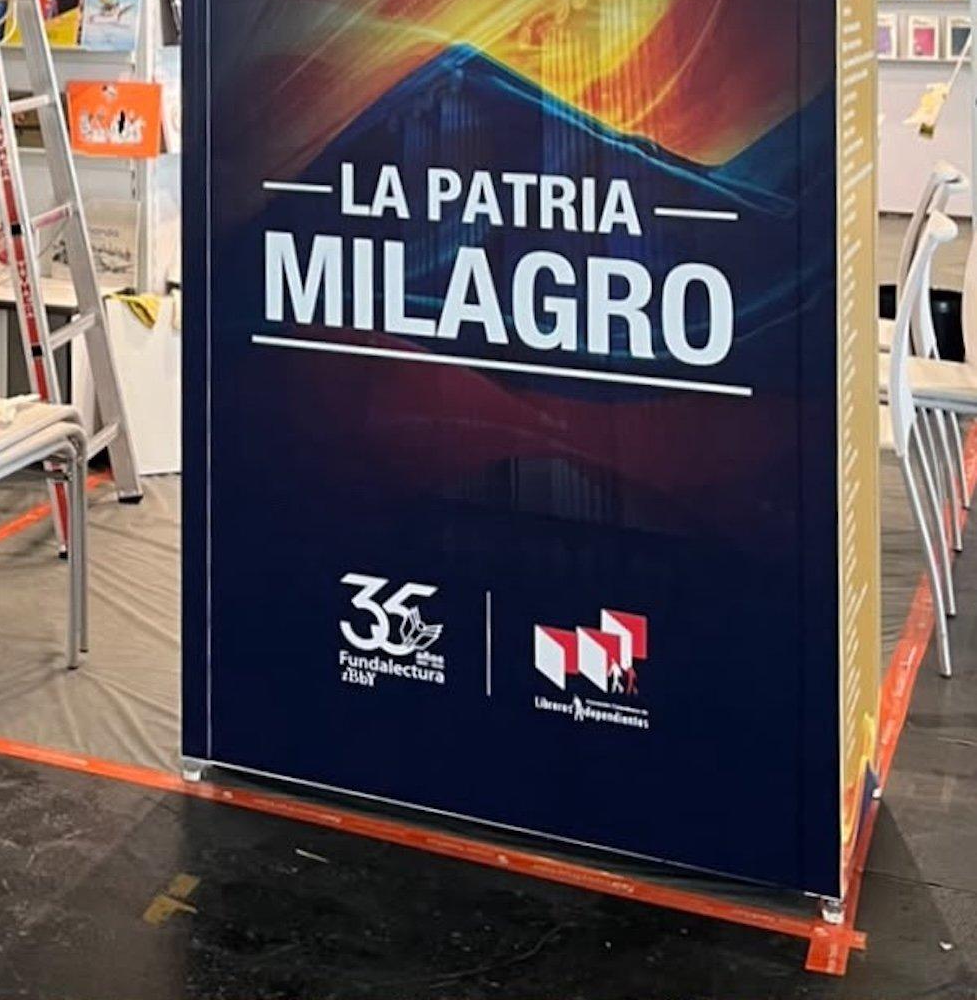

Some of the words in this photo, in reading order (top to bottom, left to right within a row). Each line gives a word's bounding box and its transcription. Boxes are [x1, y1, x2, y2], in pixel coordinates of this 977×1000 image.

[341, 162, 411, 220] LA
[427, 167, 643, 237] PATRIA
[264, 230, 735, 367] MILAGRO
[339, 650, 445, 684] Fundalectura
